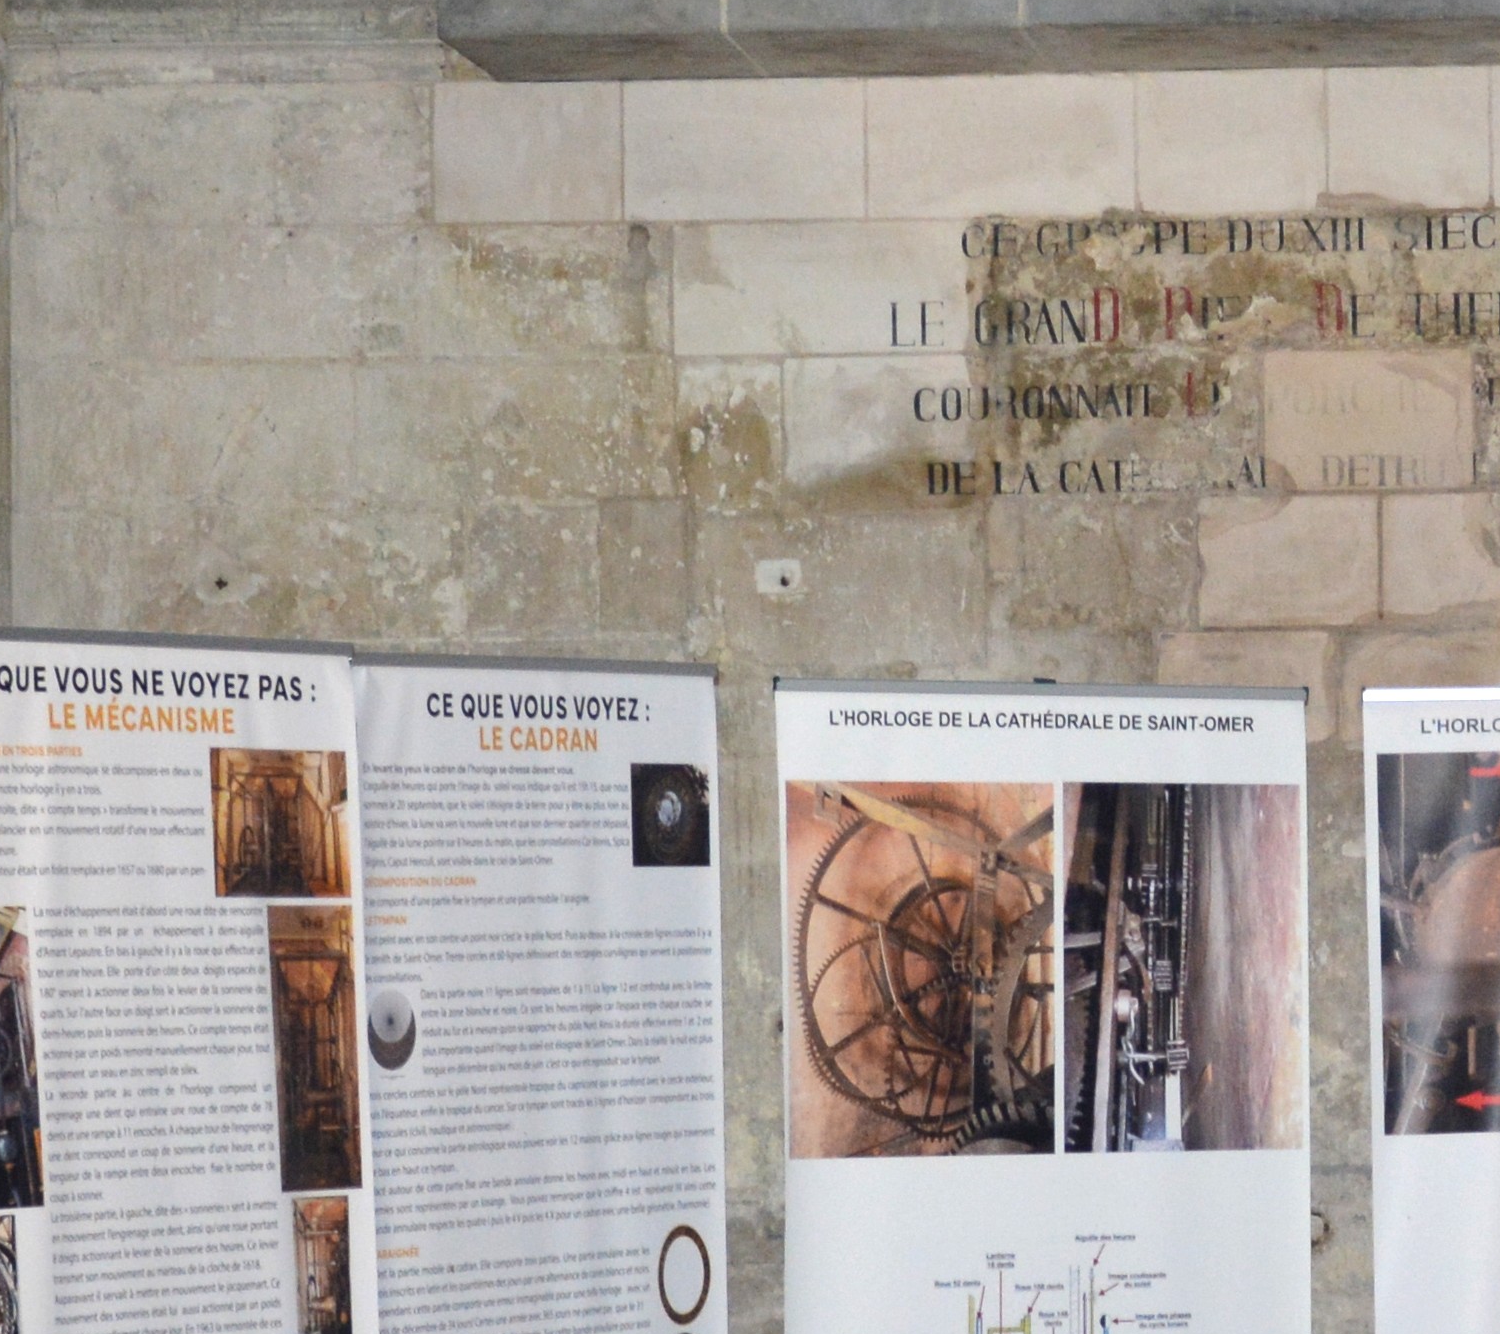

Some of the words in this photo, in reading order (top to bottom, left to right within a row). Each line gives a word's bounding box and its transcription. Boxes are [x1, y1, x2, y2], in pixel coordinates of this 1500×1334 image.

[1036, 219, 1207, 255] GRPE
[1227, 219, 1285, 253] DU
[1301, 216, 1365, 252] XIII
[889, 300, 944, 347] LE
[974, 287, 1120, 345] GRAND
[1165, 286, 1281, 341] DIE
[1315, 281, 1375, 338] DE
[913, 384, 1152, 422] COURONNAIT
[927, 461, 976, 495] DE
[993, 461, 1039, 495] LA
[54, 666, 122, 695] VOUS
[132, 668, 163, 696] NE
[170, 671, 250, 700] VOYEZ
[258, 675, 303, 702] PAS
[48, 703, 76, 731] LE
[85, 697, 235, 734] MÉCANISME
[427, 693, 454, 718] CE
[461, 694, 503, 719] QUE
[510, 696, 567, 720] VOUS
[574, 697, 639, 722] VOYEZ
[829, 709, 933, 728] L'HORLOGE
[938, 711, 963, 728] DE
[969, 712, 990, 729] LA
[996, 709, 1114, 731] CATHÉDRALE
[1119, 713, 1142, 731] DE
[1148, 714, 1254, 733] SAINT-OMER
[479, 726, 503, 750] LE
[510, 726, 598, 752] CADRAN
